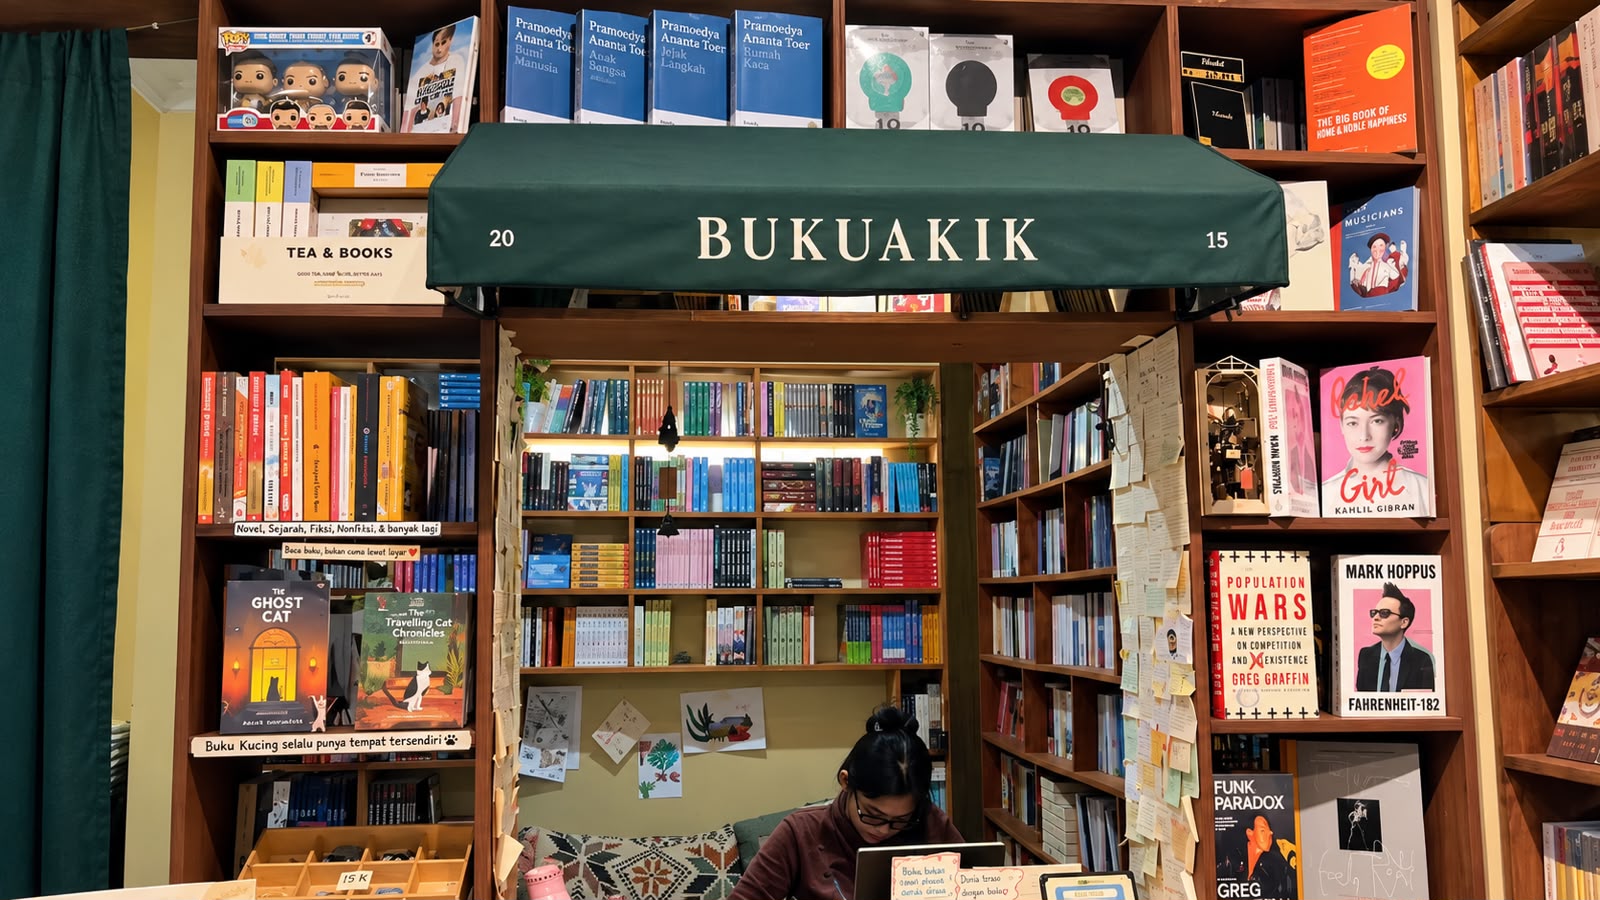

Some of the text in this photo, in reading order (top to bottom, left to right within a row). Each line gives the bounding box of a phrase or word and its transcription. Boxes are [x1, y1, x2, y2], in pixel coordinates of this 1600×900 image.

[516, 17, 573, 41] Pramoedya
[589, 20, 646, 44] Pramoedya
[661, 18, 720, 40] Pramoedya
[744, 19, 802, 36] Pramoedya
[515, 31, 553, 49] Ananta
[589, 34, 626, 52] Ananta
[661, 32, 726, 54] Ananta Toer
[743, 34, 810, 50] Ananta Toer
[516, 44, 543, 59] Bumi
[661, 46, 687, 60] Jejak
[744, 46, 781, 60] Rumah
[514, 55, 558, 74] Manusia
[660, 58, 706, 74] Langkah
[744, 58, 770, 70] Kaca
[1317, 105, 1390, 127] THE BIG BOOK OF
[1316, 128, 1336, 139] HOME
[1344, 121, 1366, 134] NOBLE
[1368, 113, 1407, 128] HAPPINESS
[1345, 206, 1403, 227] MUSICIANS
[489, 228, 515, 248] 20
[697, 217, 1038, 262] BUKUAKIK
[1206, 231, 1228, 250] 15
[286, 247, 393, 258] TEA & BOOKS
[1334, 504, 1414, 514] KAHLIL GIBRAN
[236, 524, 266, 534] Novel,
[268, 524, 306, 535] Sejarah,
[310, 524, 334, 534] Fiksi,
[378, 524, 386, 532] &
[388, 524, 418, 535] banyak
[422, 524, 438, 535] lagi
[324, 547, 345, 555] bukan
[1346, 564, 1436, 579] MARK HOPPUS
[1228, 576, 1305, 588] POPULATION
[252, 596, 303, 609] GHOST
[1228, 593, 1306, 620] WARS
[262, 610, 292, 622] CAT
[408, 608, 424, 616] The
[385, 618, 452, 629] Travelling Cat
[1231, 626, 1307, 636] A NEW PERSPECTIVE
[392, 628, 445, 638] Chronicles
[1237, 641, 1302, 650] ON COMPETITION
[1232, 656, 1248, 664] AND
[1232, 672, 1309, 686] GREG GRAFFIN
[1348, 698, 1440, 711] FAHRENHEIT-182
[206, 734, 442, 752] Buku Kucing selalu punya tempat tersendiri
[1214, 780, 1254, 795] FUNK
[1215, 796, 1284, 810] PARADOX
[360, 874, 368, 882] K
[1218, 882, 1261, 898] GREG
